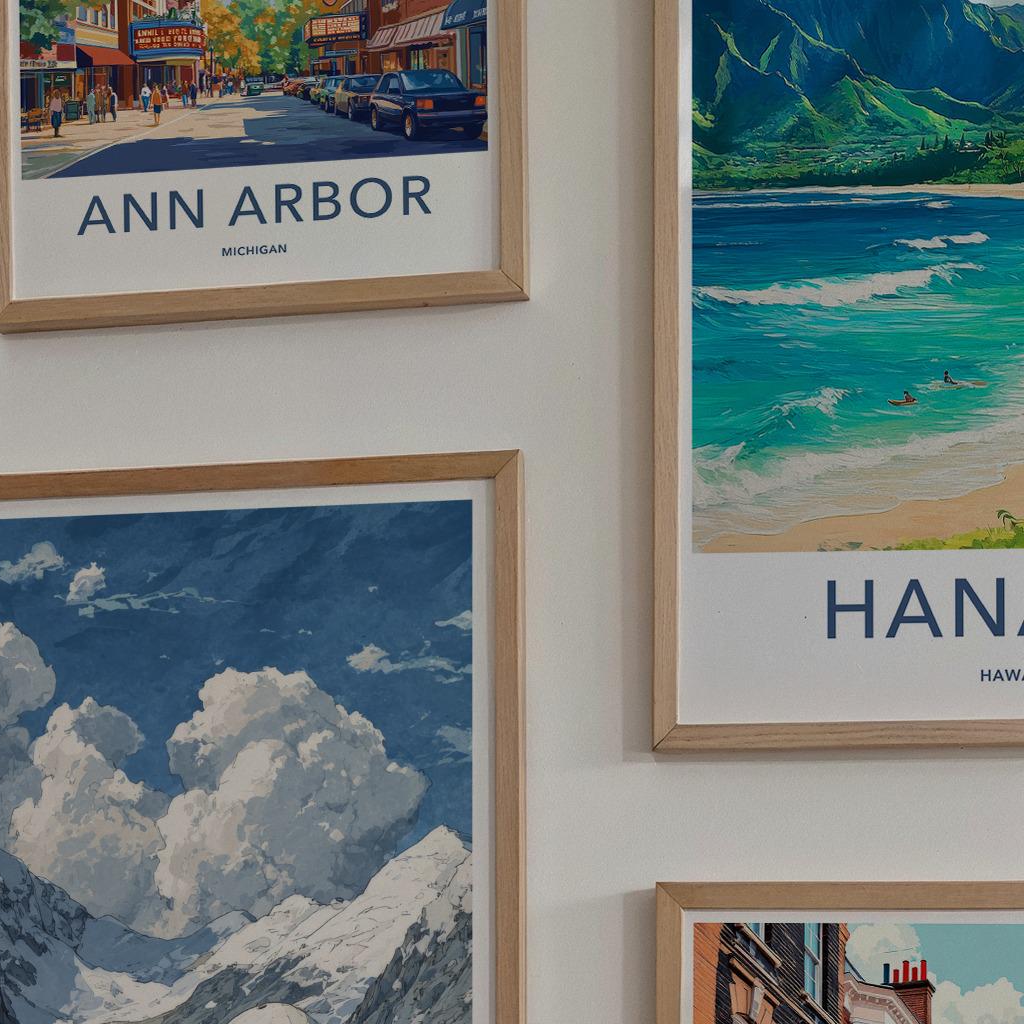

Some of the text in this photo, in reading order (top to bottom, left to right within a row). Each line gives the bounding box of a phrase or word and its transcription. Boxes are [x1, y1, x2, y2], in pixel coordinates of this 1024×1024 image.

[77, 174, 432, 236] ANN ARBOR
[221, 243, 288, 257] MICHIGAN
[827, 577, 1024, 639] HAN
[980, 669, 1024, 682] HAW
